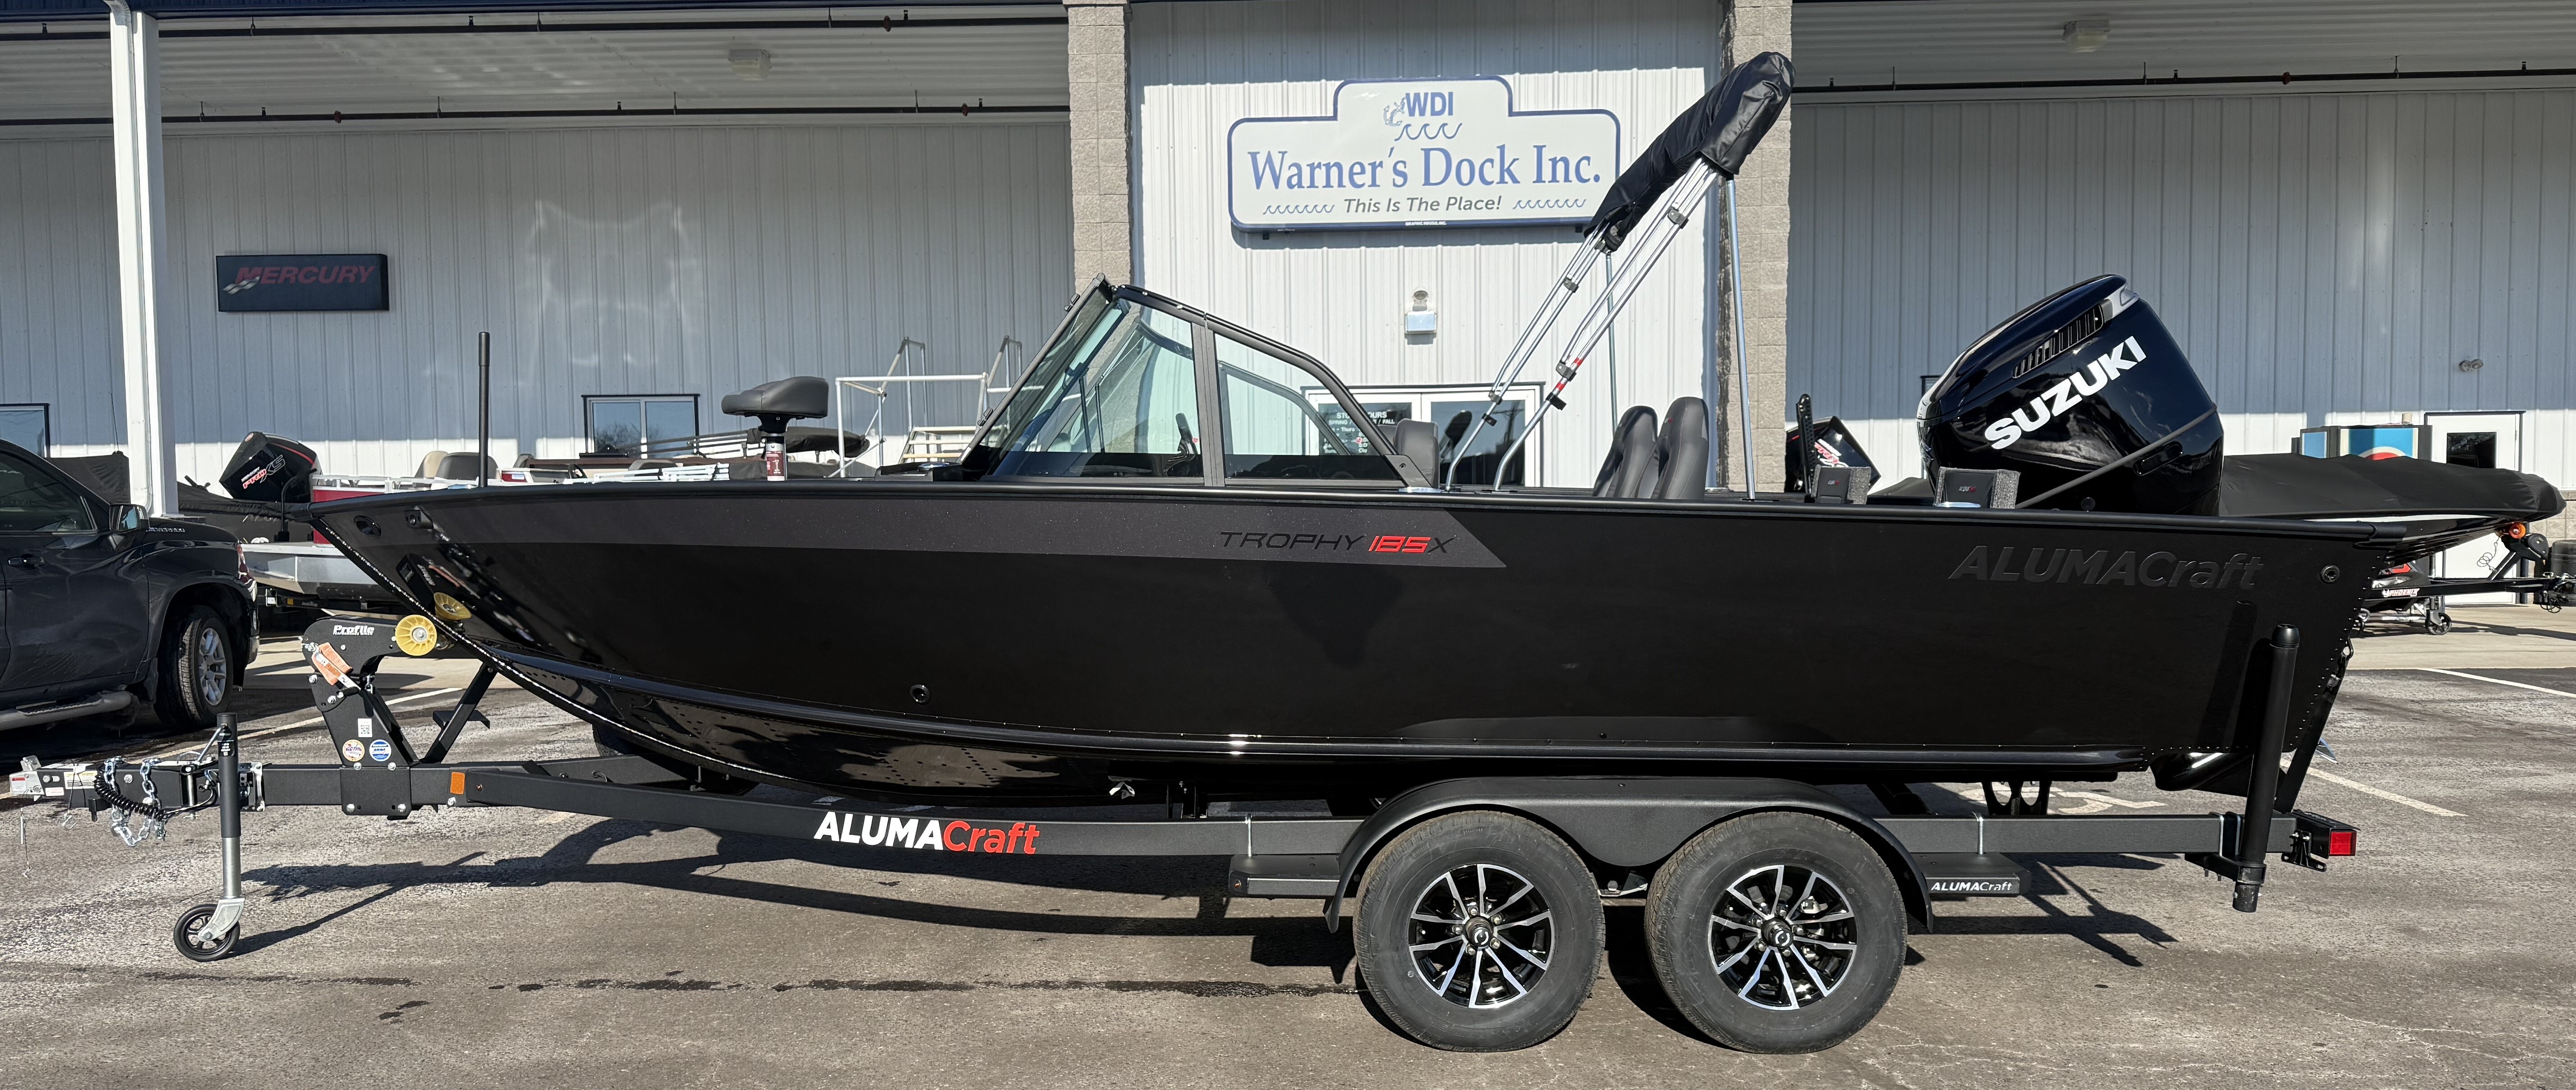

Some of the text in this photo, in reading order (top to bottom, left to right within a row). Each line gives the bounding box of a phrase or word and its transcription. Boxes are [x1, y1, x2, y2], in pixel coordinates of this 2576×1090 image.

[1405, 92, 1454, 117] WDI
[1247, 143, 1601, 190] Warner's Dock Inc.
[1344, 195, 1502, 214] This Is The Place!
[235, 266, 375, 284] MERCURY
[1985, 336, 2146, 449] SUZUKI
[1220, 531, 1366, 551] TROPHY
[1948, 545, 2264, 588] ALUMACraft
[333, 625, 375, 634] Profile
[814, 811, 1040, 854] ALUMACraft
[1931, 882, 2012, 891] ALUMACraft
